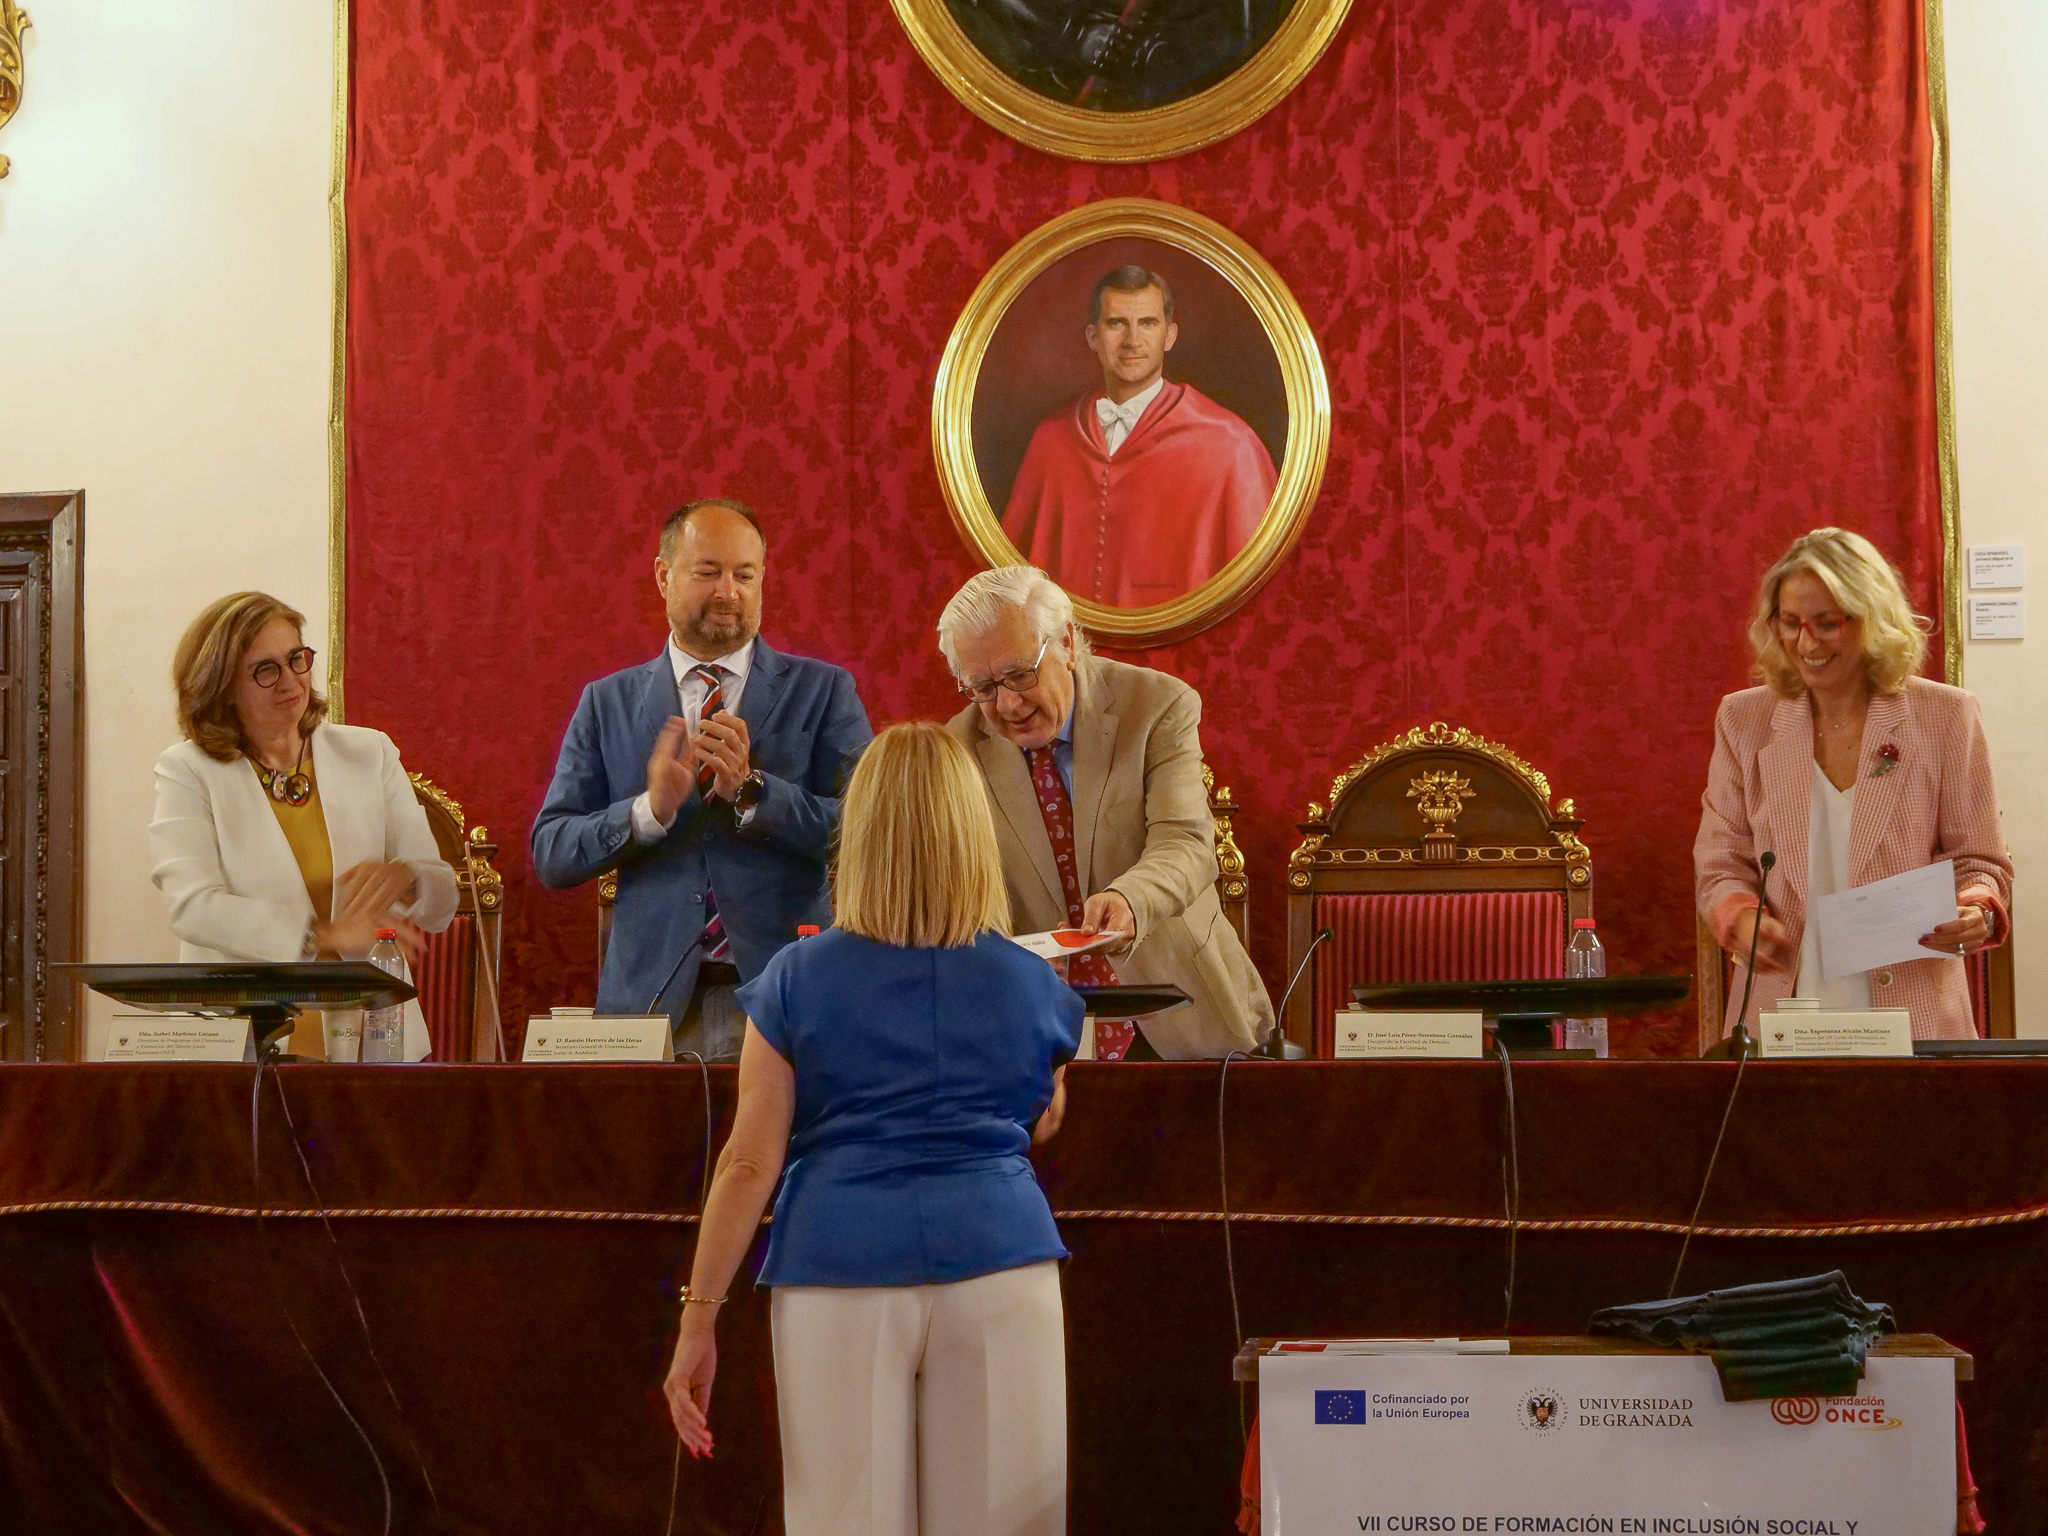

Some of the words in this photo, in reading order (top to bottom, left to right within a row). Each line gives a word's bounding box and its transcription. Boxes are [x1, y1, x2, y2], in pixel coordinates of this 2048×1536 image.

[1372, 1394, 1447, 1404] Cofinanciado
[1450, 1395, 1470, 1406] por
[1579, 1398, 1693, 1410] UNIVERSIDAD
[1825, 1396, 1885, 1406] Fundación
[1372, 1408, 1383, 1418] la
[1385, 1408, 1419, 1418] Unión
[1422, 1408, 1470, 1420] Europea
[1579, 1415, 1600, 1427] DE
[1602, 1413, 1694, 1427] GRANADA
[1825, 1408, 1885, 1424] ONCE
[1357, 1516, 1381, 1532] VII
[1386, 1516, 1456, 1533] CURSO
[1462, 1516, 1488, 1532] DE
[1494, 1513, 1614, 1533] FORMACIÓN
[1620, 1517, 1647, 1534] EN
[1652, 1514, 1759, 1535] INCLUSIÓN
[1766, 1519, 1841, 1536] SOCIAL
[1845, 1519, 1859, 1535] Y
